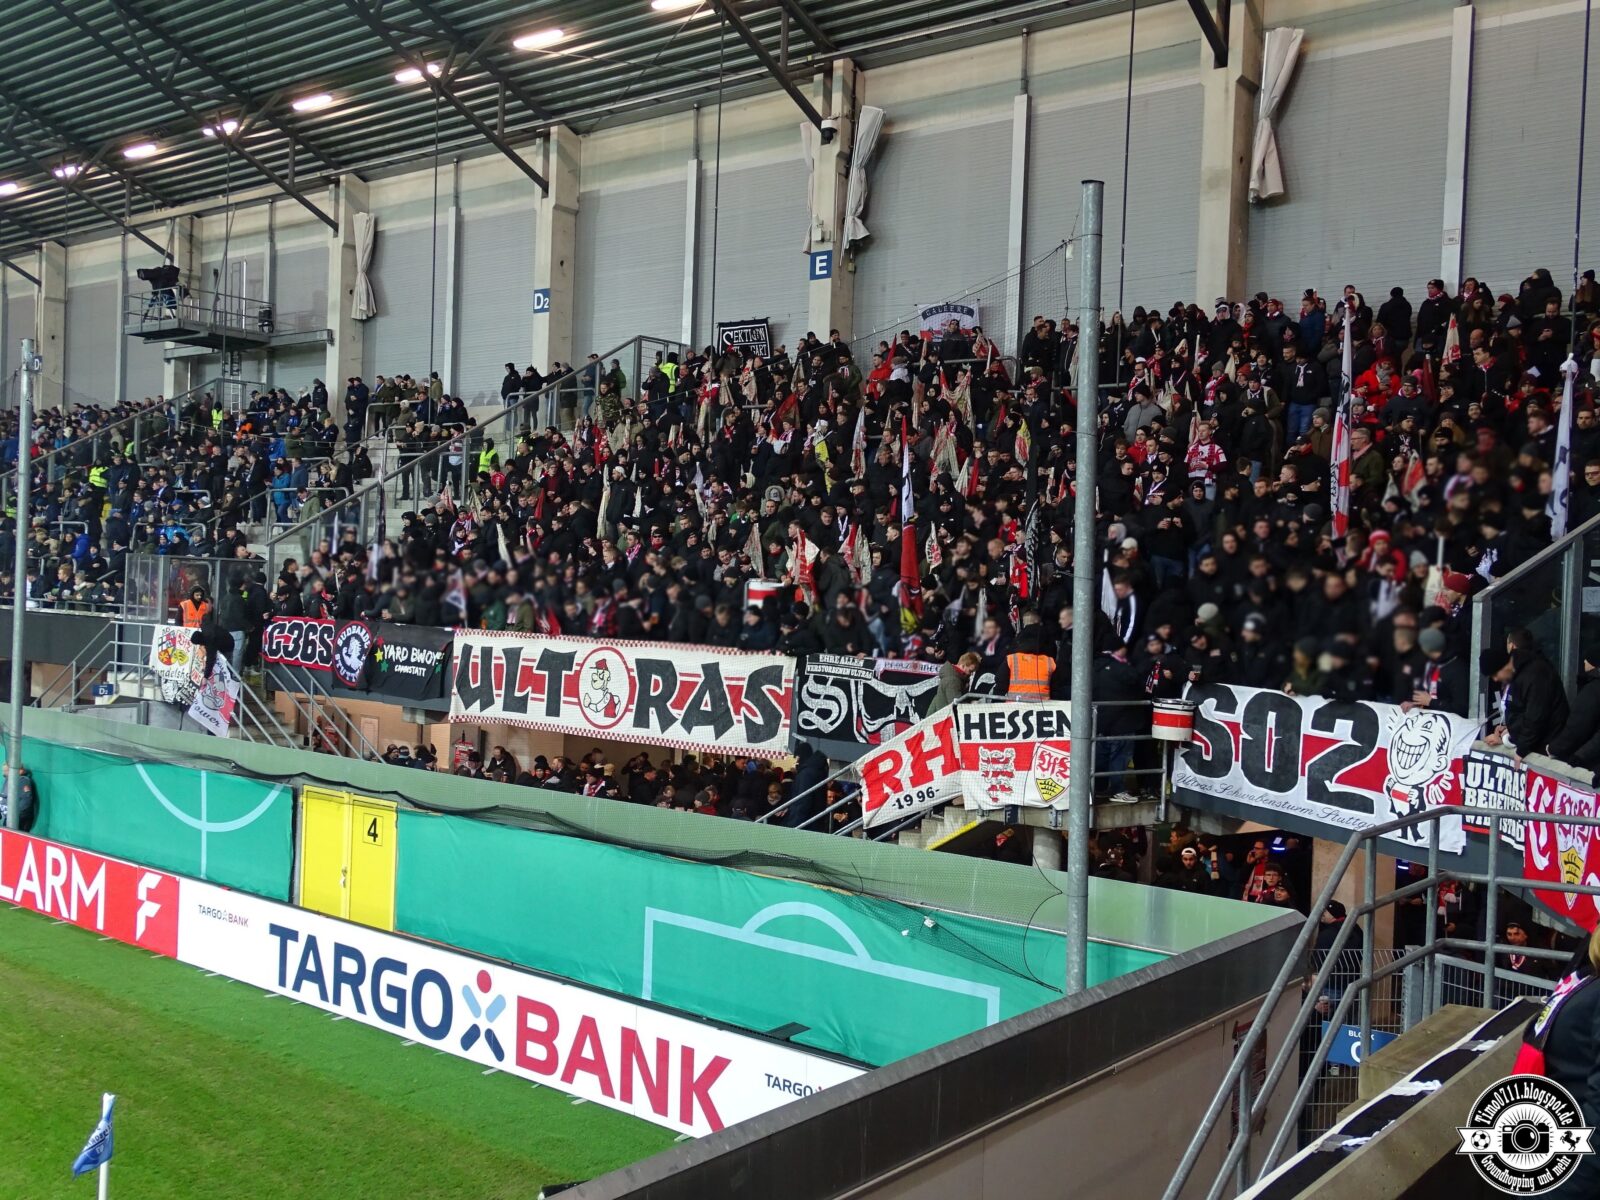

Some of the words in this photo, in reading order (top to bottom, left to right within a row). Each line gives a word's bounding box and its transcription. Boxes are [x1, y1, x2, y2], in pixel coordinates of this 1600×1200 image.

[815, 255, 828, 275] E
[534, 293, 549, 310] D2
[383, 644, 408, 663] YARD
[862, 716, 961, 812] RH
[1466, 762, 1526, 801] ULTRAS
[366, 817, 379, 843] 4
[1316, 807, 1377, 831] Stuttga
